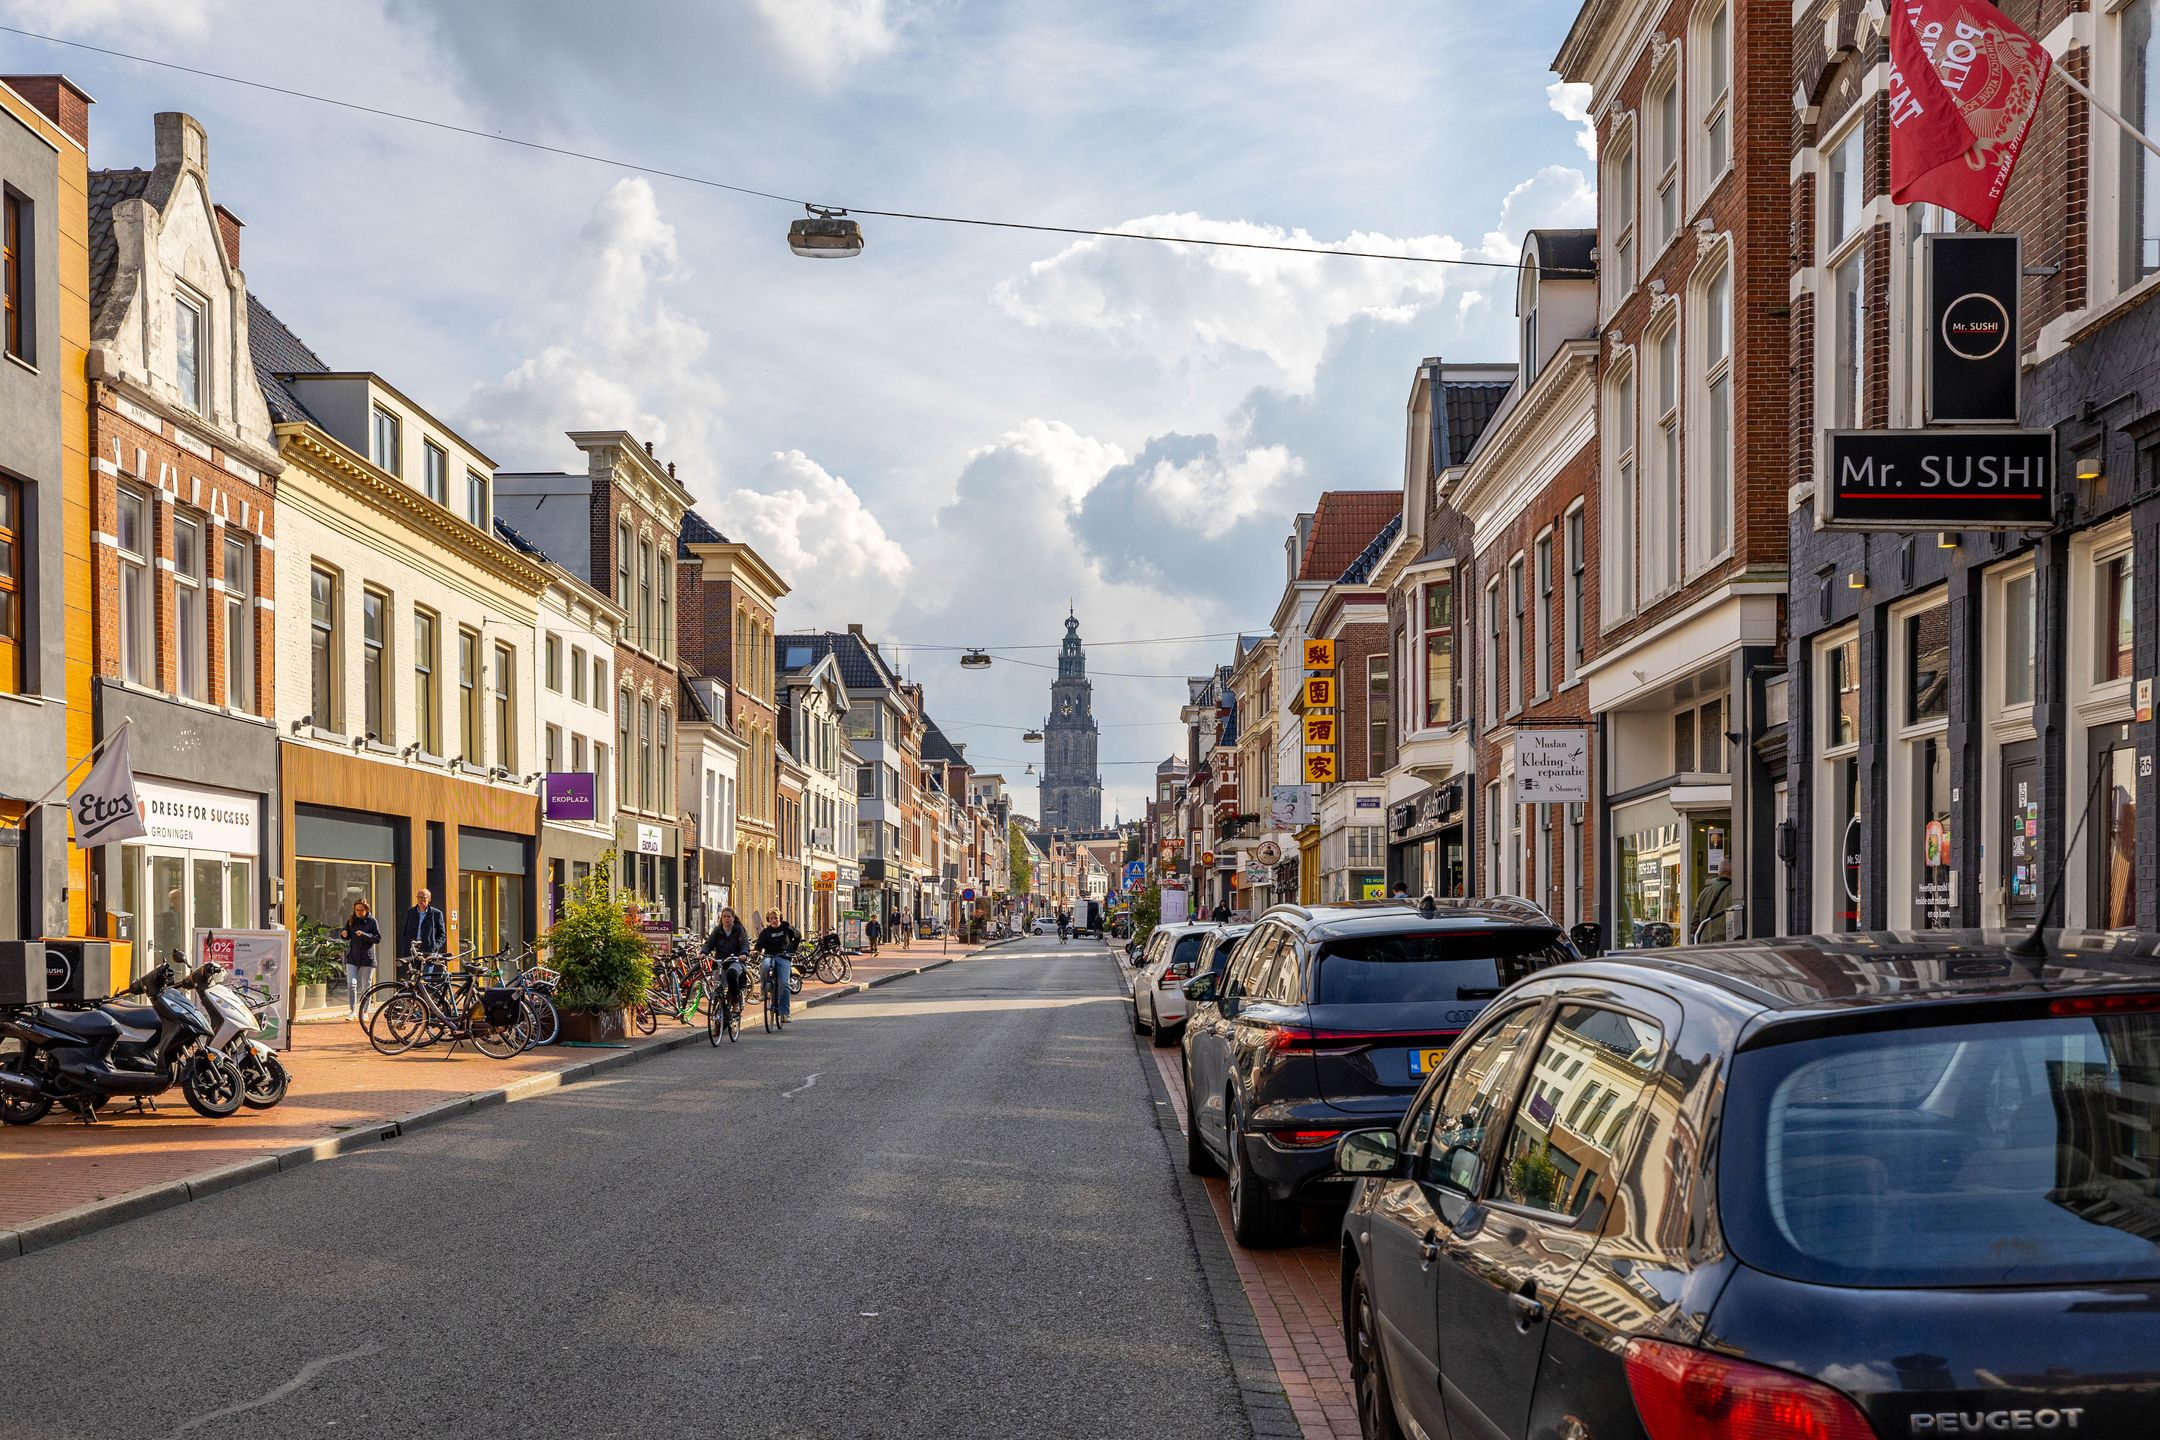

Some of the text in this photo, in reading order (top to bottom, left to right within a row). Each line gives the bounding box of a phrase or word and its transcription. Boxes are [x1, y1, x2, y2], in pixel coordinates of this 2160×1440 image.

[1952, 321, 1999, 331] Mr. SUSHI
[1841, 455, 2044, 488] Mr. SUSHI
[1308, 645, 1333, 779] 梨園酒家
[1535, 736, 1567, 748] Mustan
[1522, 752, 1568, 768] Kleding-
[2140, 759, 2151, 773] 56
[1538, 765, 1585, 778] reparatie
[78, 793, 133, 826] Etos
[151, 799, 250, 826] DRESS FOR SUCCESS
[151, 826, 194, 841] GRONINGEN
[642, 840, 658, 852] EKOPLAZA
[1910, 1408, 2085, 1434] PEUGEOT
